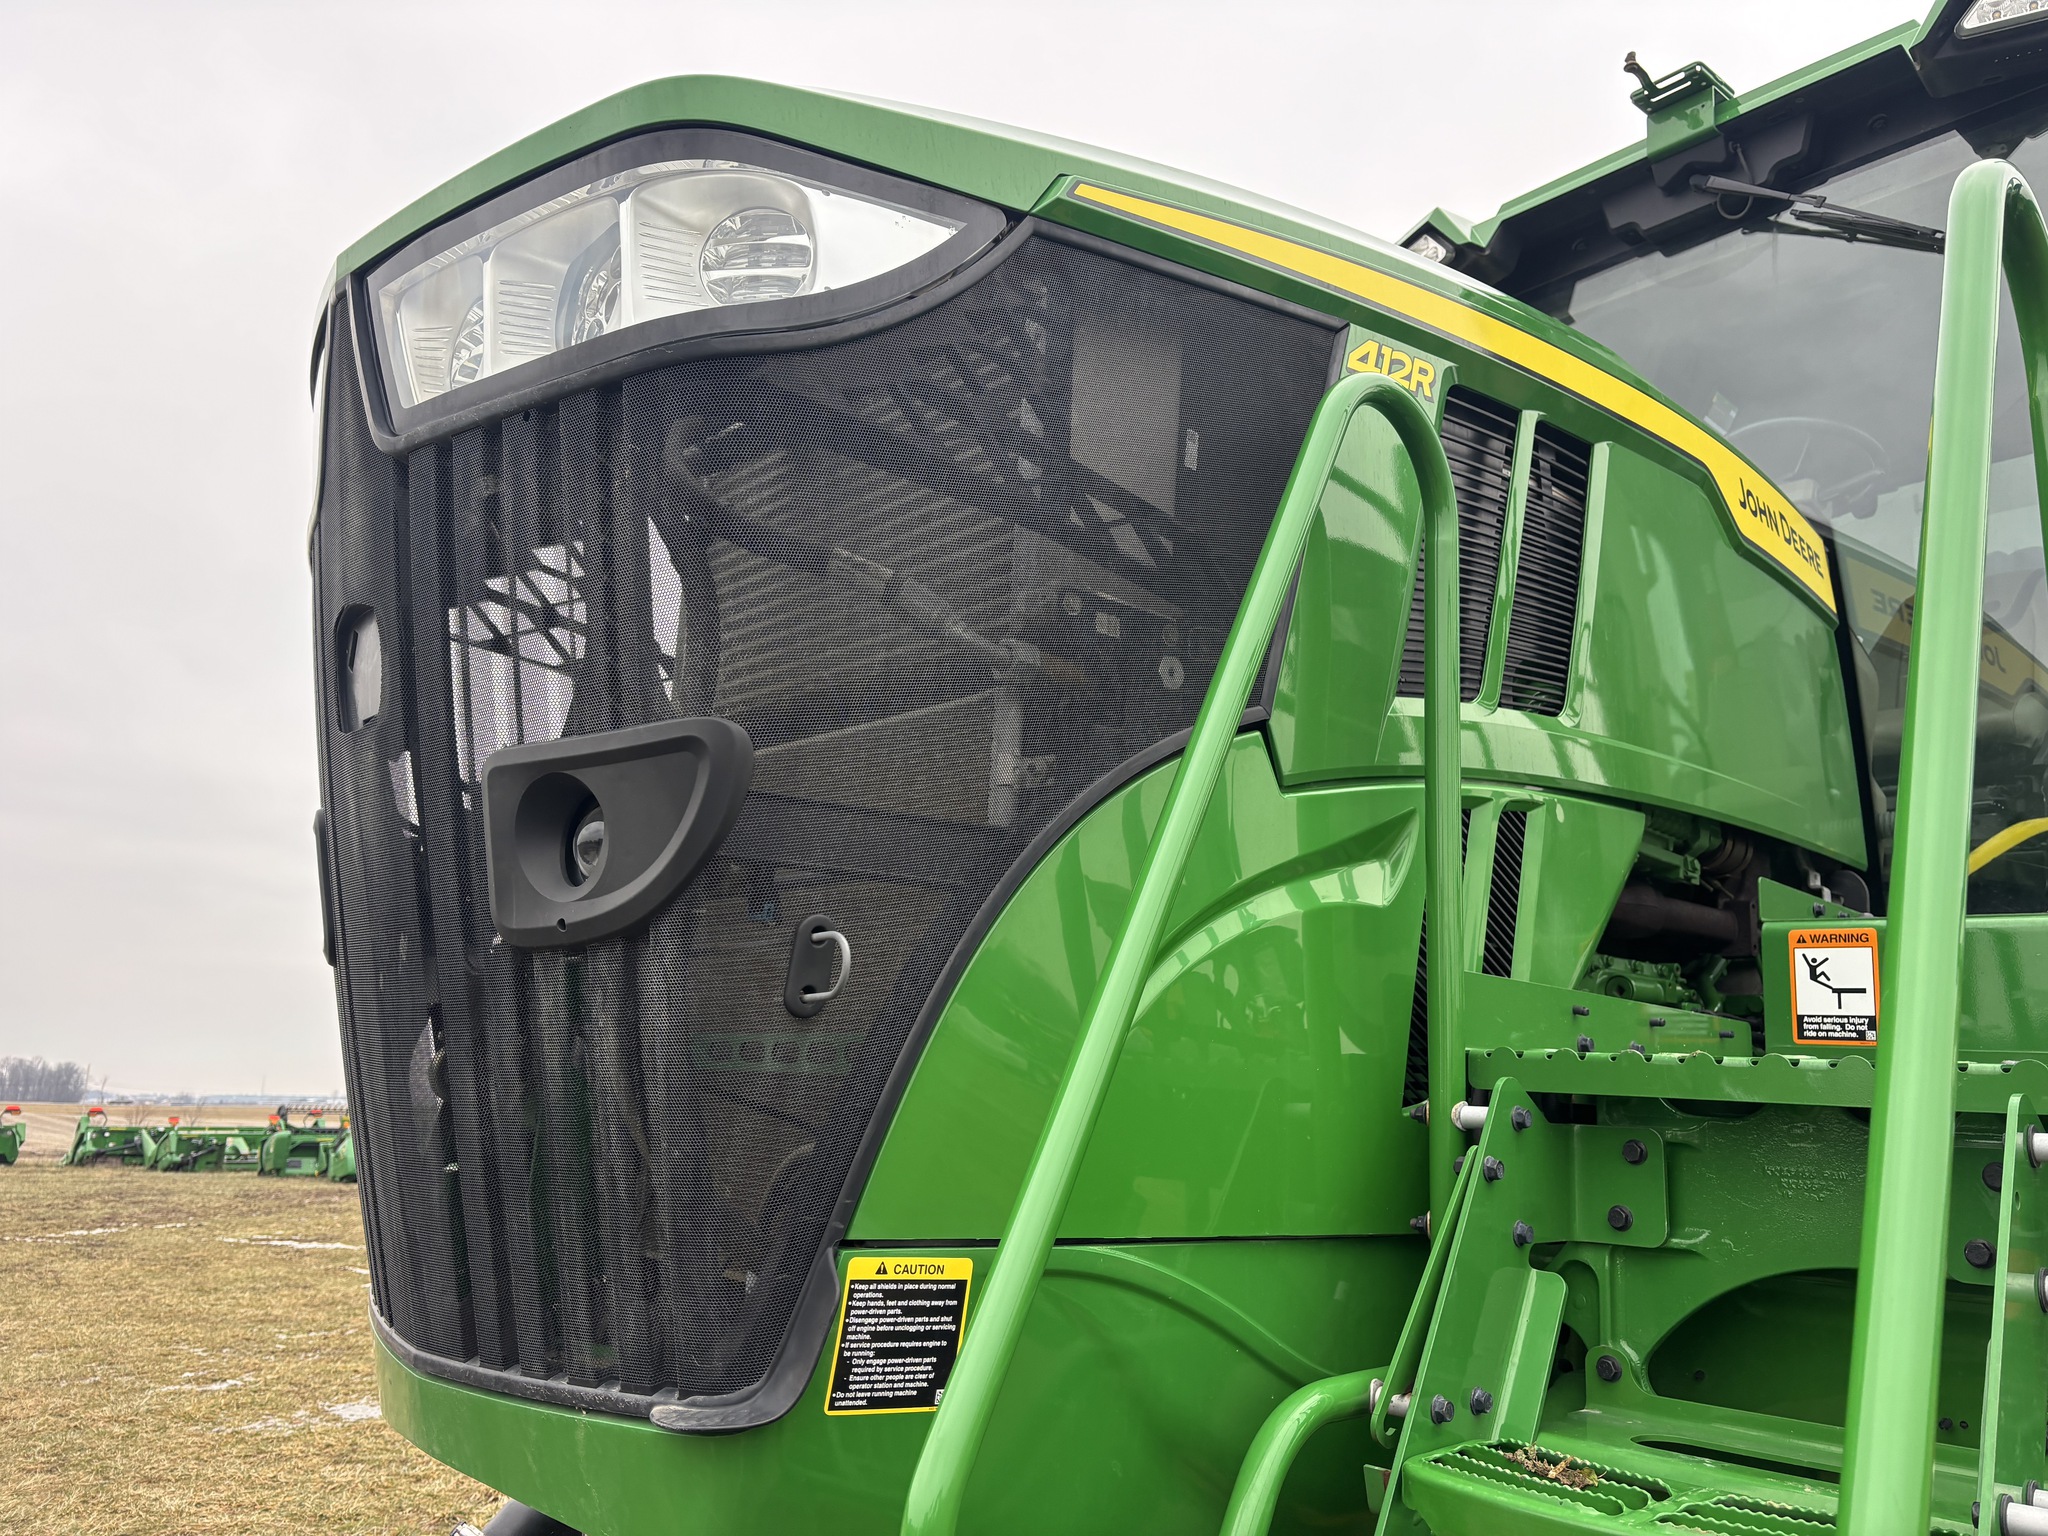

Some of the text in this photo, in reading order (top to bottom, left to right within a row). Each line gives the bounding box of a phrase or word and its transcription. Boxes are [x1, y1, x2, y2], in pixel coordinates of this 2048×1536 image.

[1346, 338, 1434, 403] 412R
[1738, 477, 1824, 579] JOHN DEERE
[1810, 933, 1869, 943] WARNING
[894, 1264, 944, 1275] CAUTION
